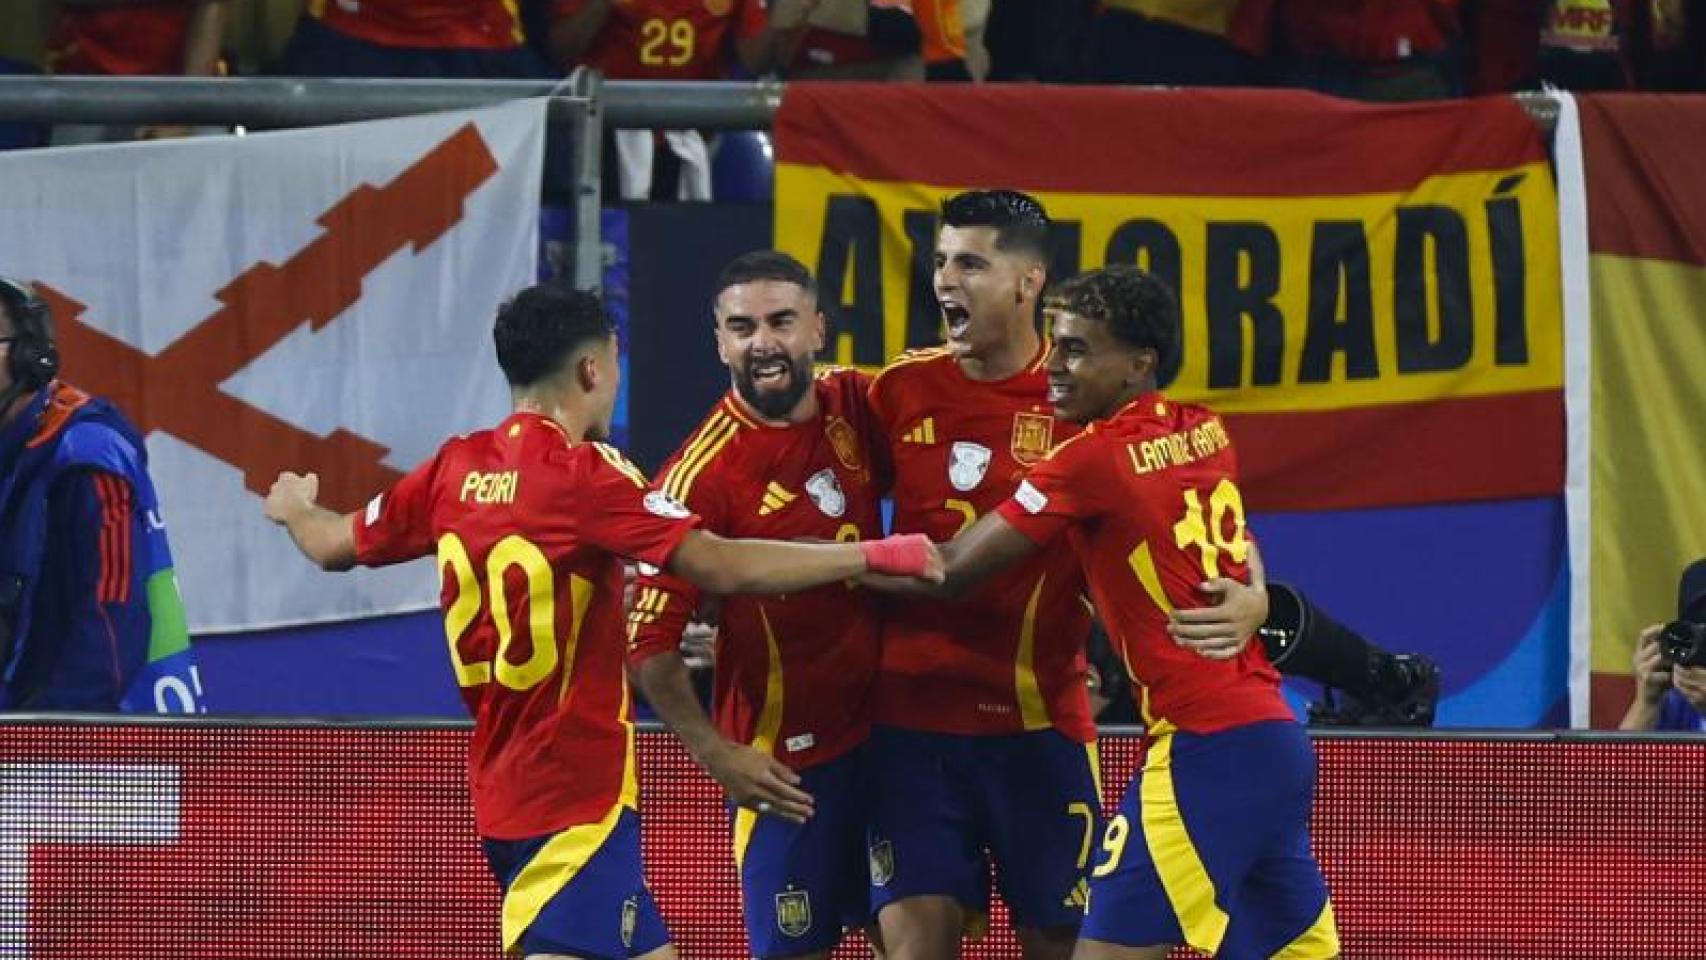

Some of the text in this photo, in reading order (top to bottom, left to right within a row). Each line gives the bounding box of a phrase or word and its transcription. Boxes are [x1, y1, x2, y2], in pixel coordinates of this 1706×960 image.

[639, 18, 696, 66] 29
[459, 470, 519, 503] PEDRI
[1173, 478, 1247, 580] 19
[436, 531, 559, 691] 20
[1068, 803, 1094, 869] 7
